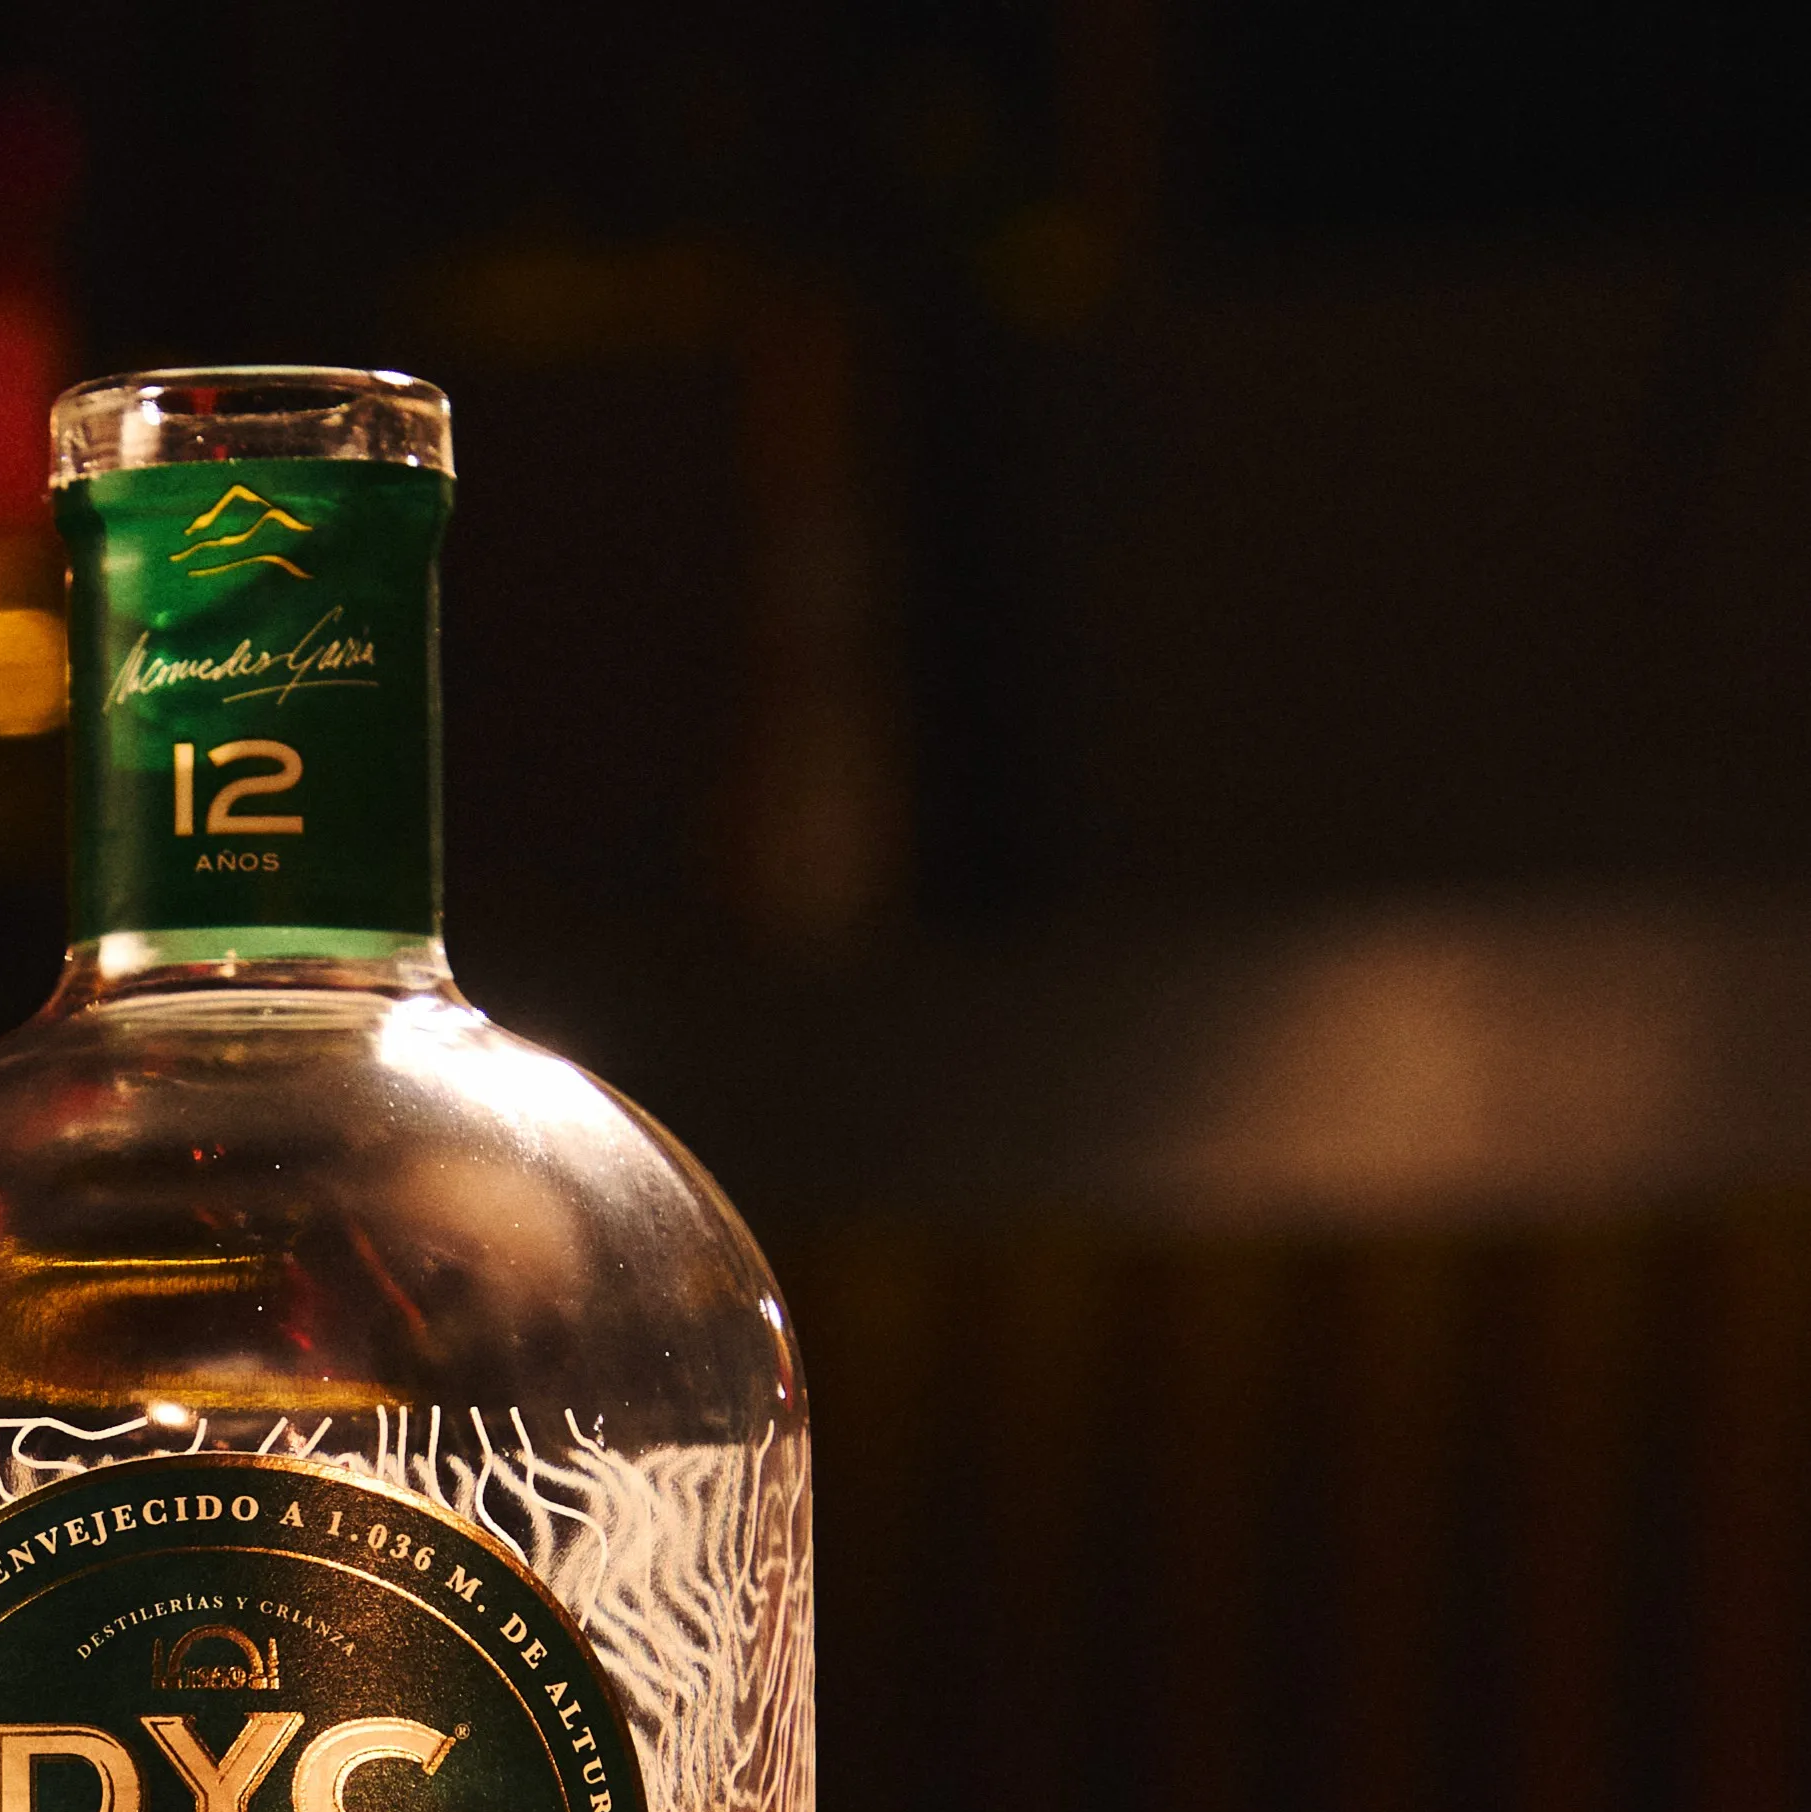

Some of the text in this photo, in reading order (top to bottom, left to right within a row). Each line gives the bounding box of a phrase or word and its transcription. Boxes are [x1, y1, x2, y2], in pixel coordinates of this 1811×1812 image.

[173, 739, 305, 836] 12
[195, 848, 281, 873] AÑOS
[76, 1592, 358, 1660] DESTILERÍAS Y CRIANZA
[278, 1499, 306, 1529] A
[326, 1510, 438, 1573] 1.036
[444, 1563, 488, 1614] M.
[498, 1611, 549, 1672] DE
